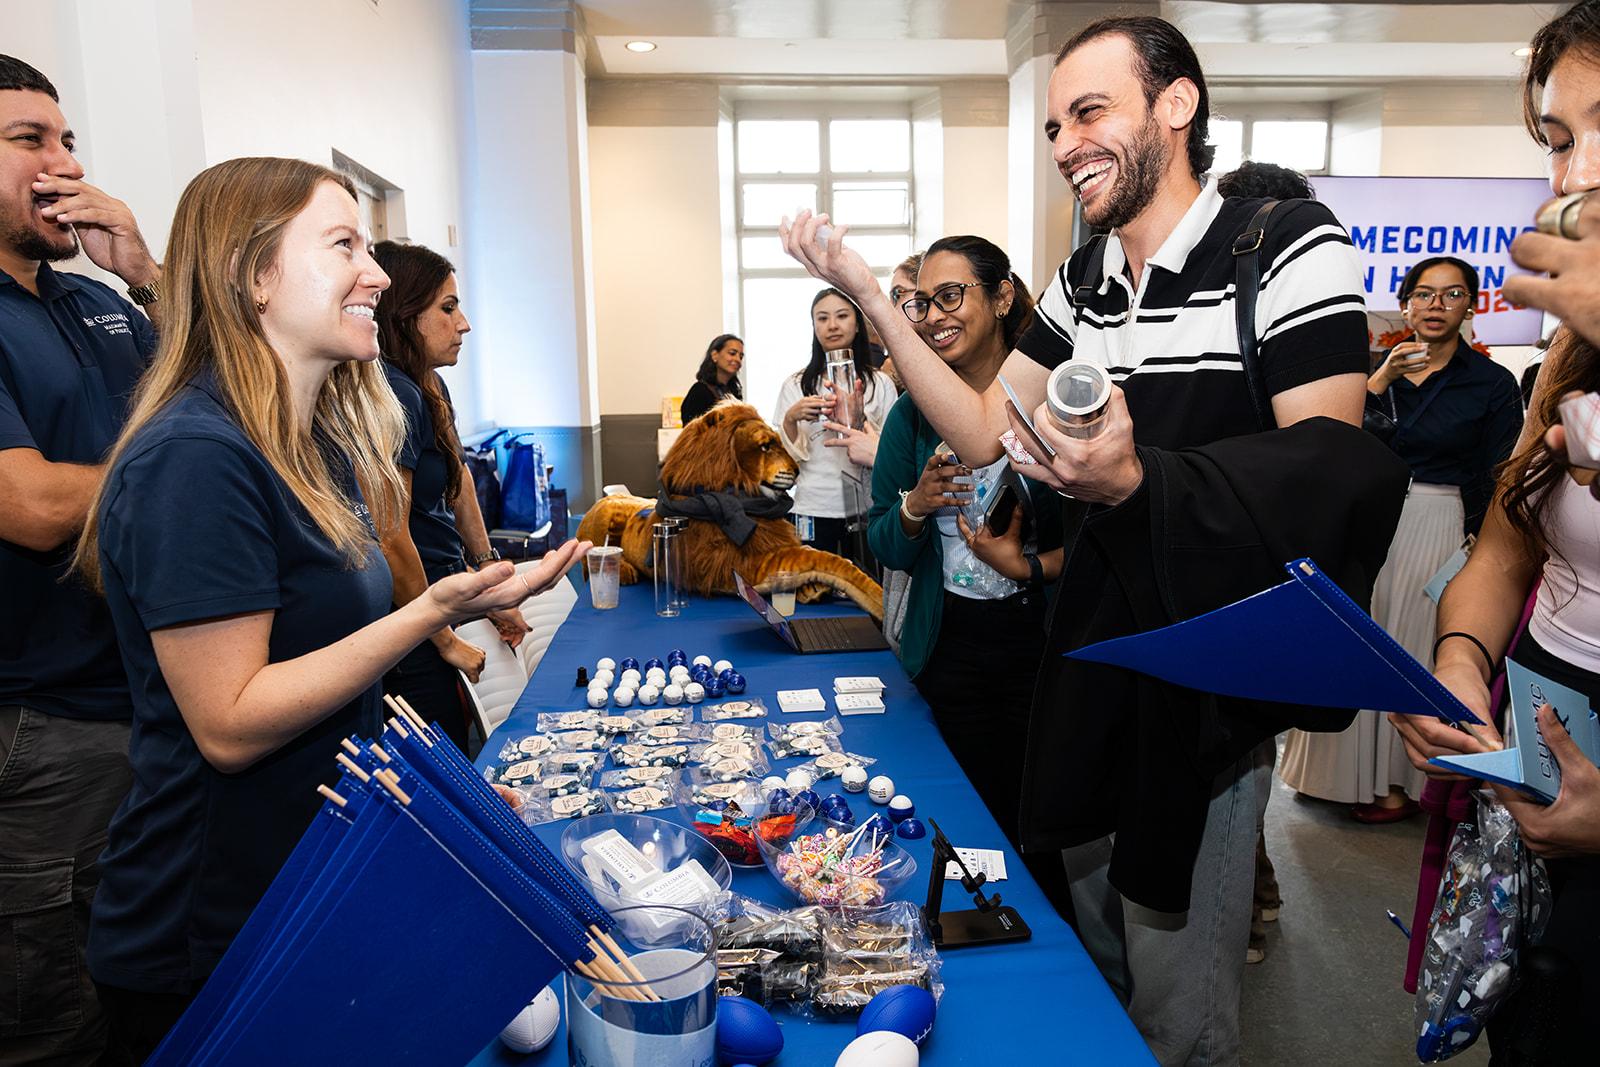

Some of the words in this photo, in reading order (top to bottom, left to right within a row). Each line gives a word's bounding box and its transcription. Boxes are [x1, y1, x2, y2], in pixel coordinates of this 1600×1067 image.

[1351, 226, 1537, 254] MECOMIN
[1530, 682, 1552, 779] CUC
[653, 870, 689, 893] COLUMBIA
